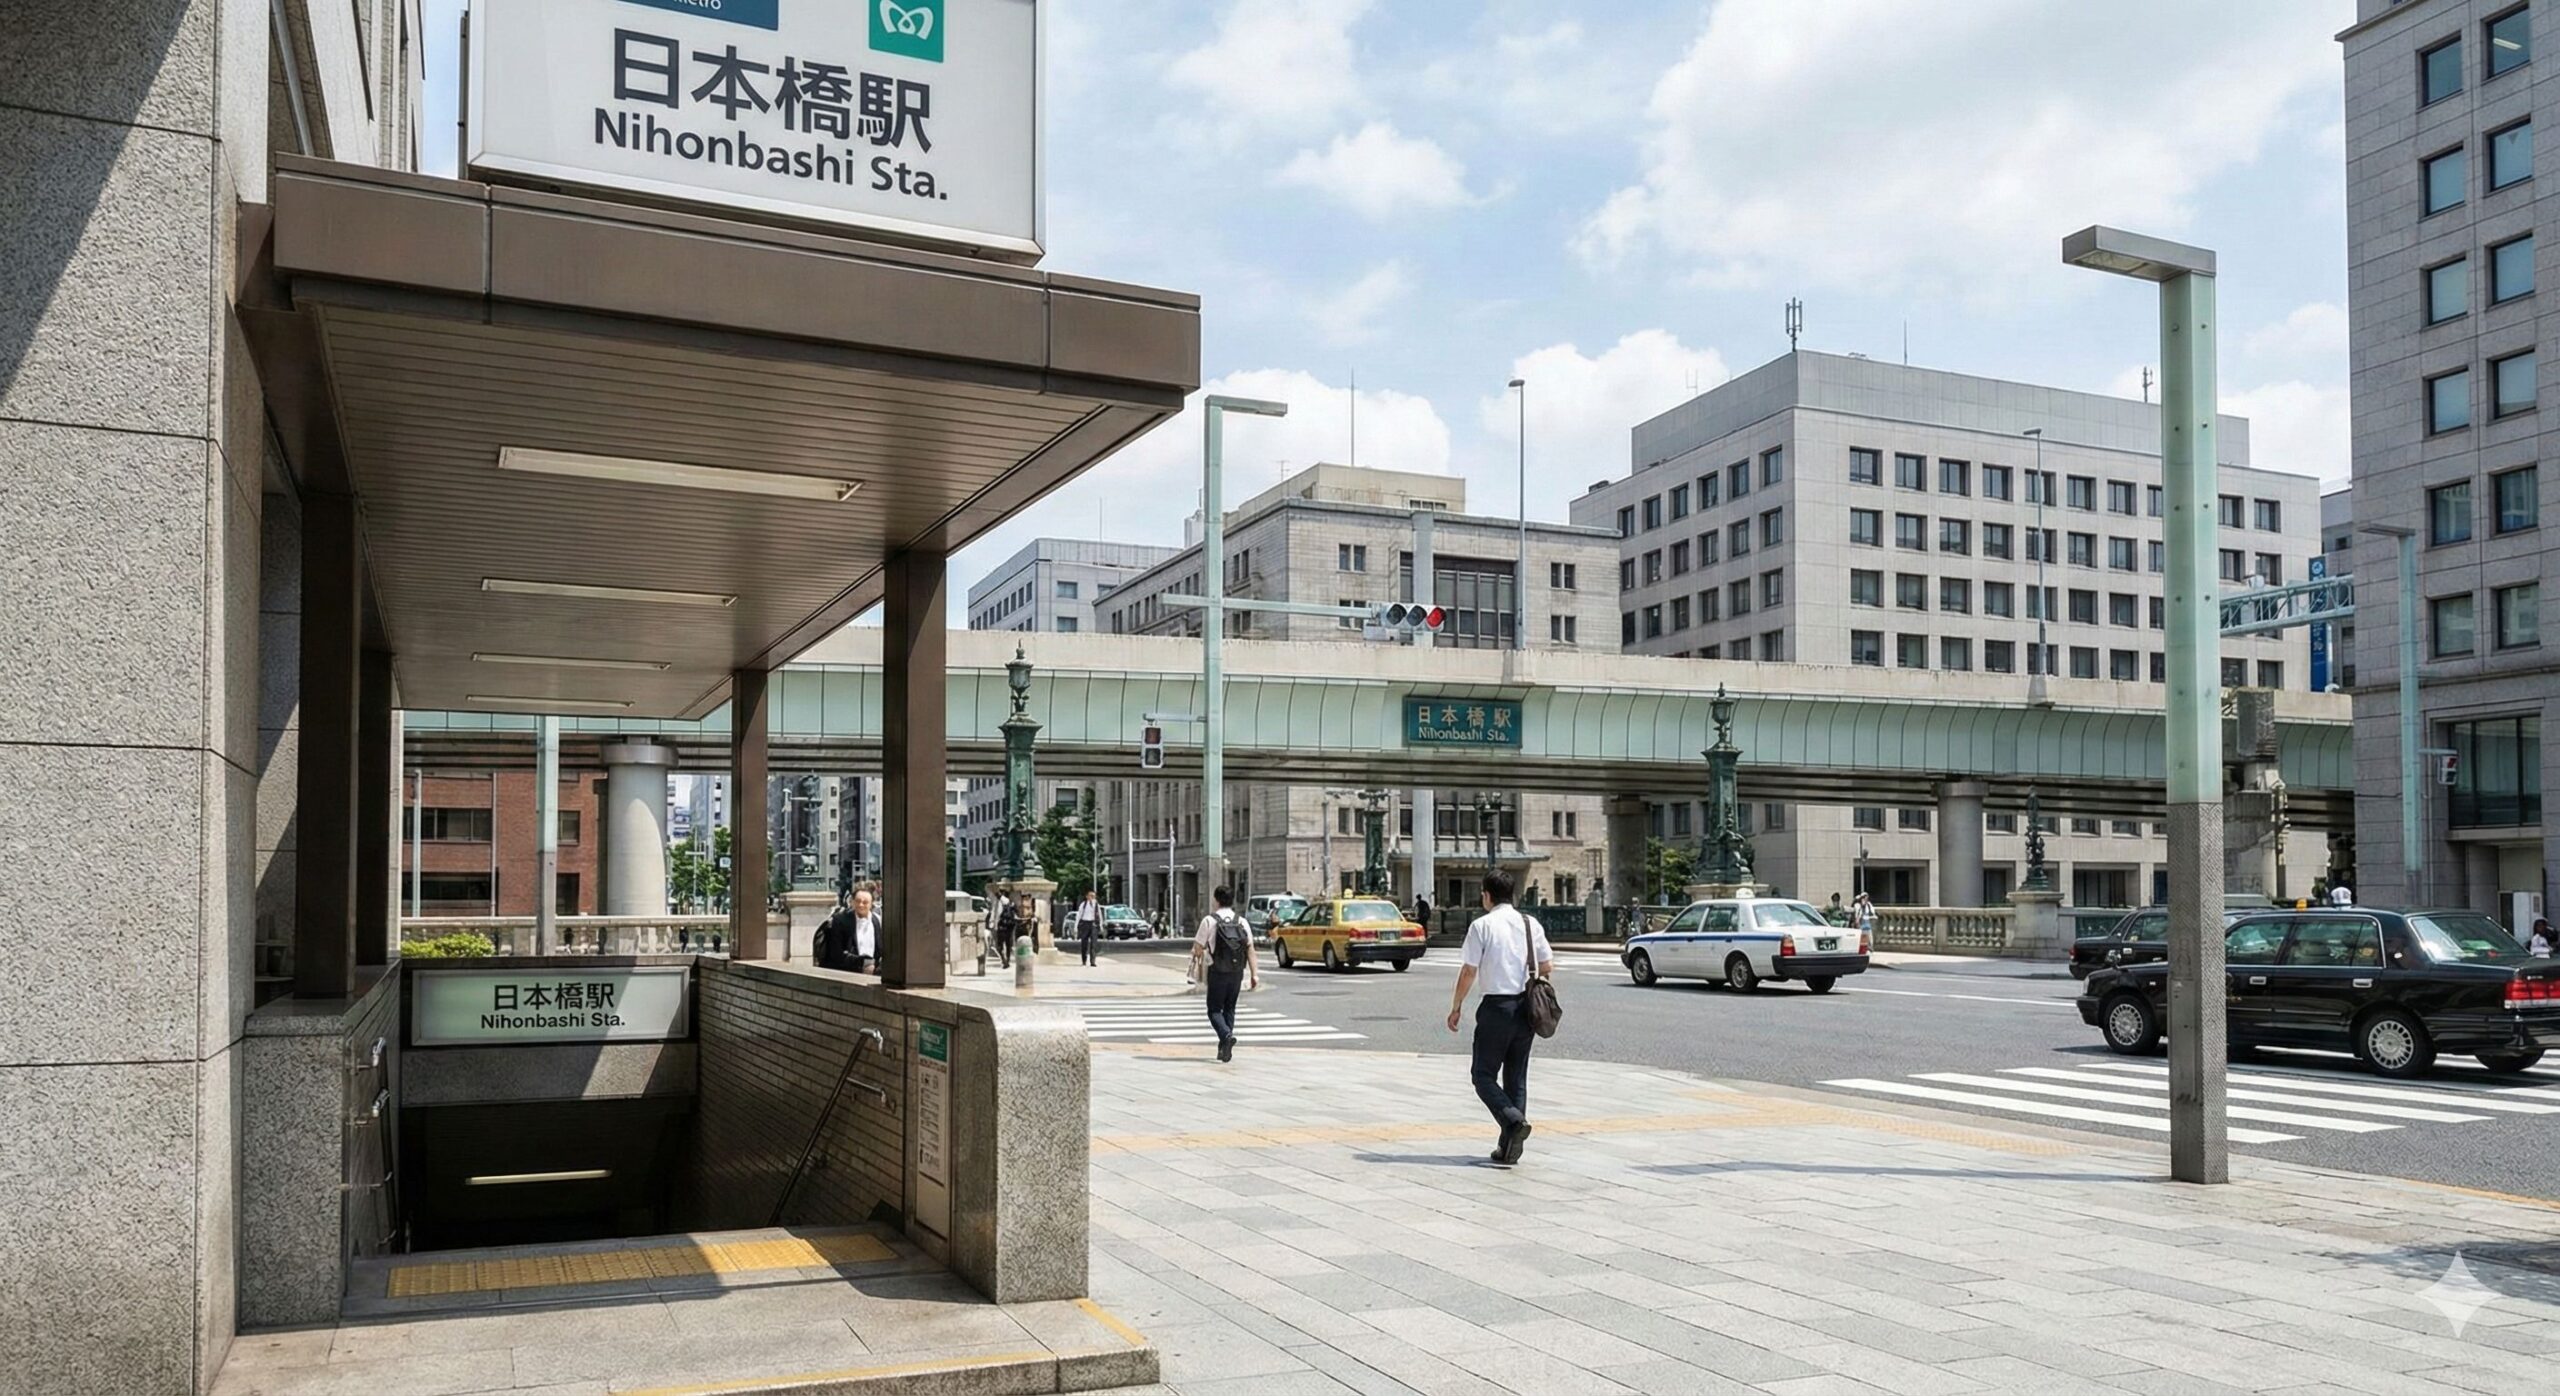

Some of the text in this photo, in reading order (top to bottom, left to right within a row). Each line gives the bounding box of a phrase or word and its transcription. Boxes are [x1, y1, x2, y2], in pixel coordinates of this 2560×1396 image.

[614, 28, 932, 154] 日本橋駅
[595, 107, 948, 201] Nihonbashi Sta.
[1418, 704, 1512, 729] 日本橋駅
[1418, 726, 1483, 741] Nihonbashi
[494, 982, 615, 1011] 日本橋駅
[481, 1012, 626, 1029] Nihonbashi Sta.
